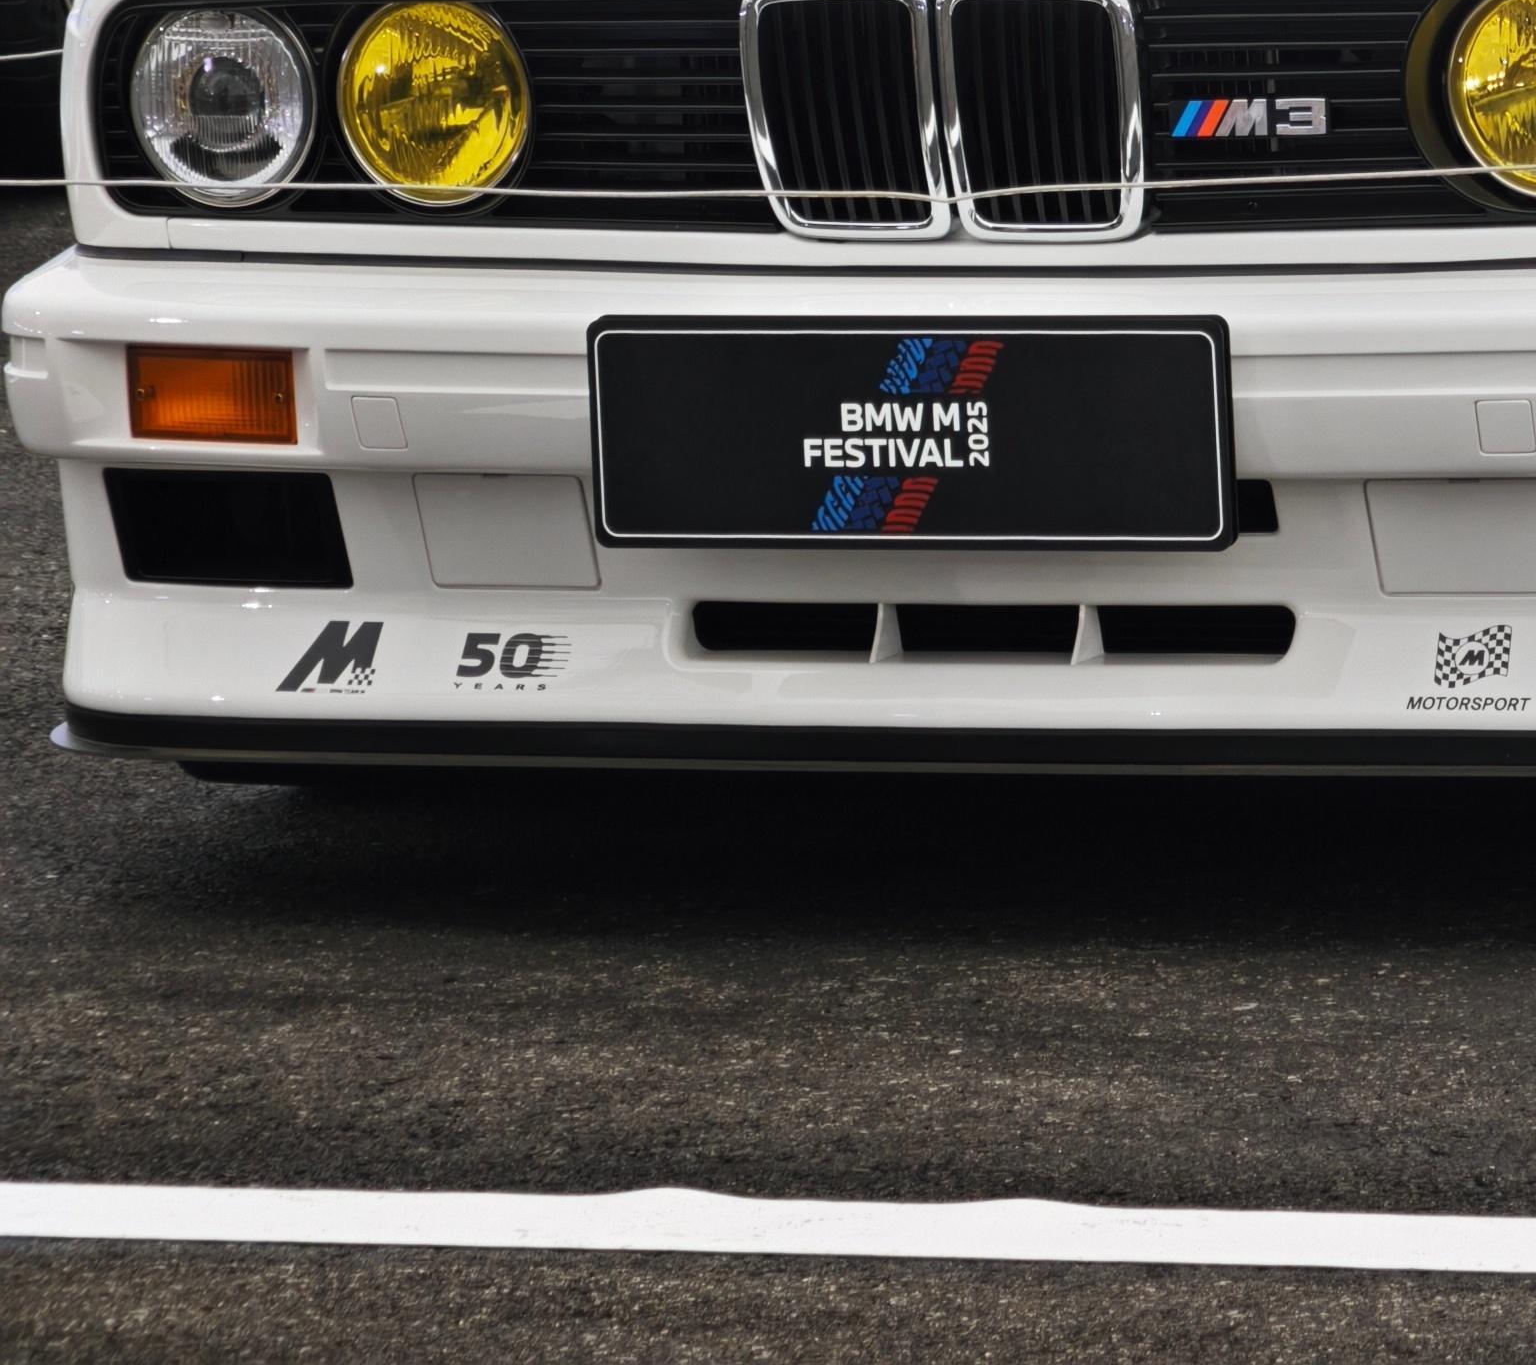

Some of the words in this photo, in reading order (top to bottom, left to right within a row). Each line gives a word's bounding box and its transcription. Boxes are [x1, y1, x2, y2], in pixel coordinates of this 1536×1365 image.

[840, 402, 924, 432] BMW
[932, 402, 961, 432] M
[966, 401, 990, 468] 2025
[803, 438, 964, 468] FESTIVAL
[456, 632, 545, 679] 50
[1458, 649, 1486, 667] M
[453, 682, 548, 691] YEARS
[1406, 696, 1532, 711] MOTORSPORT
